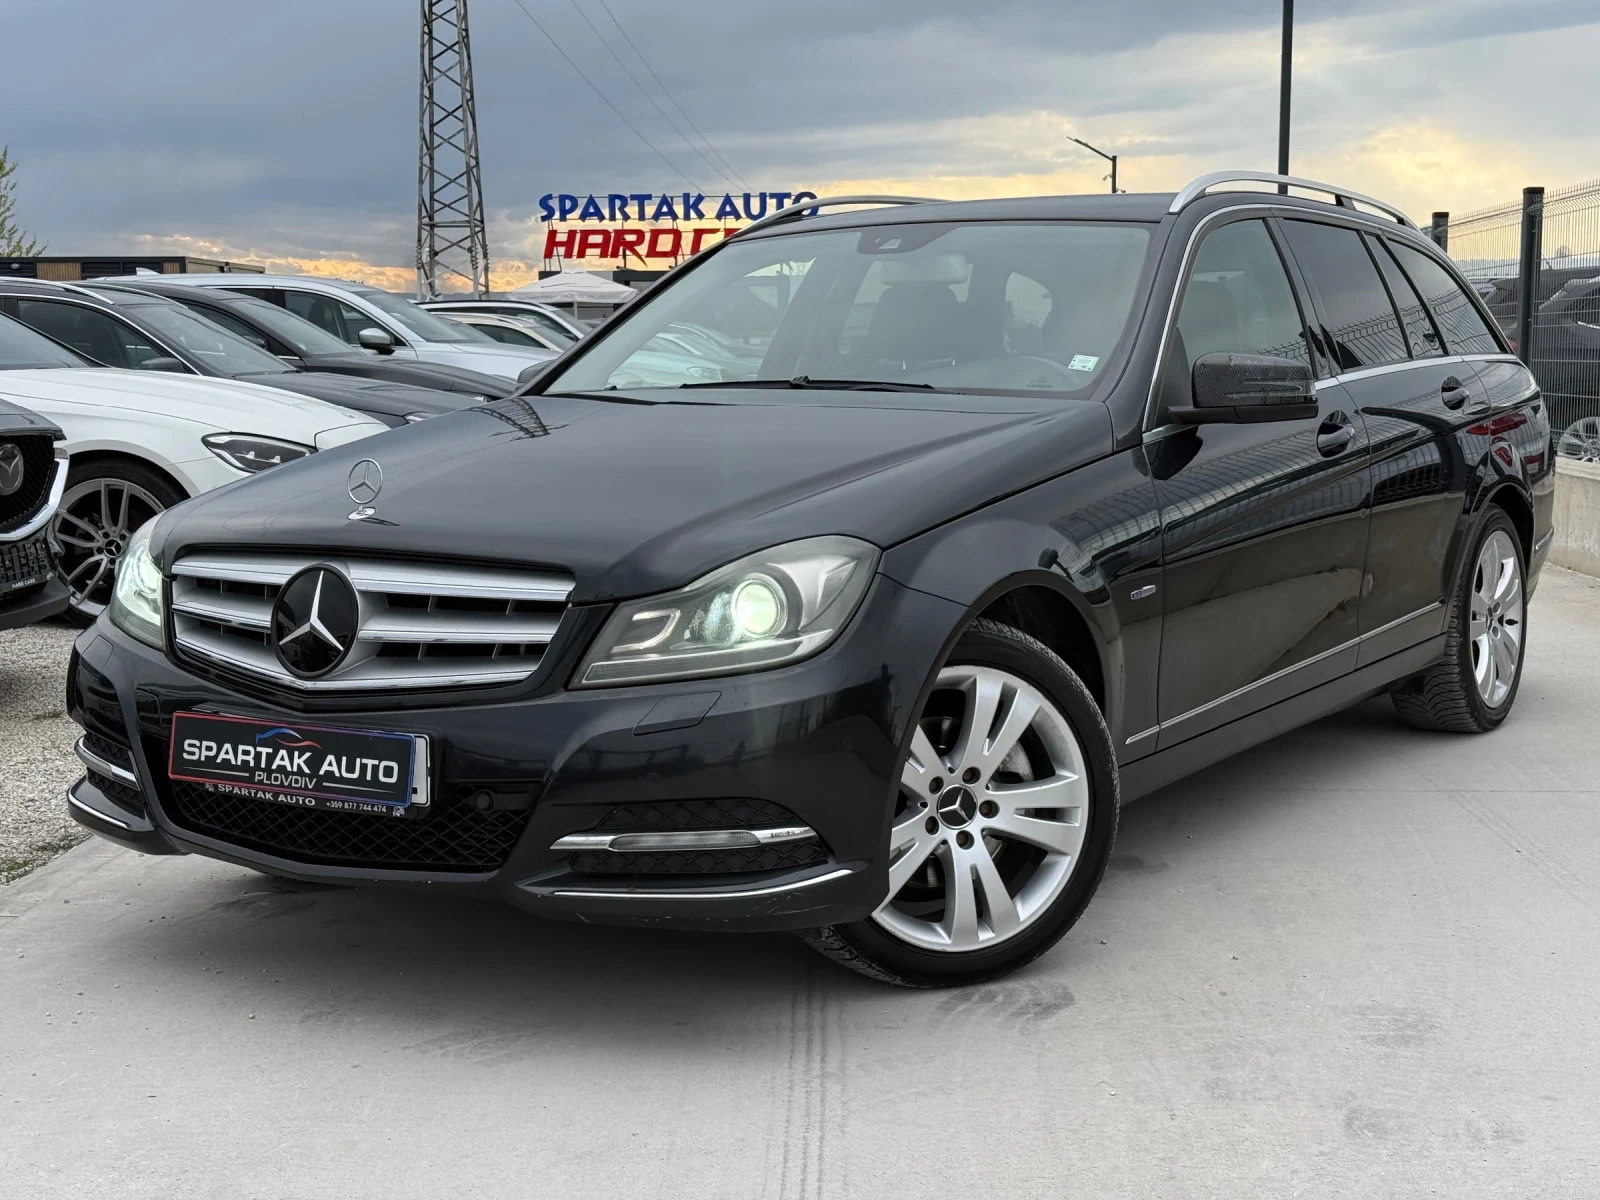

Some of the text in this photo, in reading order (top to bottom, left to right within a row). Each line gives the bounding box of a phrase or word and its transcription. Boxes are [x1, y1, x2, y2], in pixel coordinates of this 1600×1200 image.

[539, 191, 820, 222] SPARTAK AUTO
[543, 228, 683, 268] HARD
[182, 738, 398, 784] SPARTAK AUTO
[254, 771, 317, 789] PLOVDIV
[217, 784, 387, 813] SPARTAK AUTO +359 877 744 474
